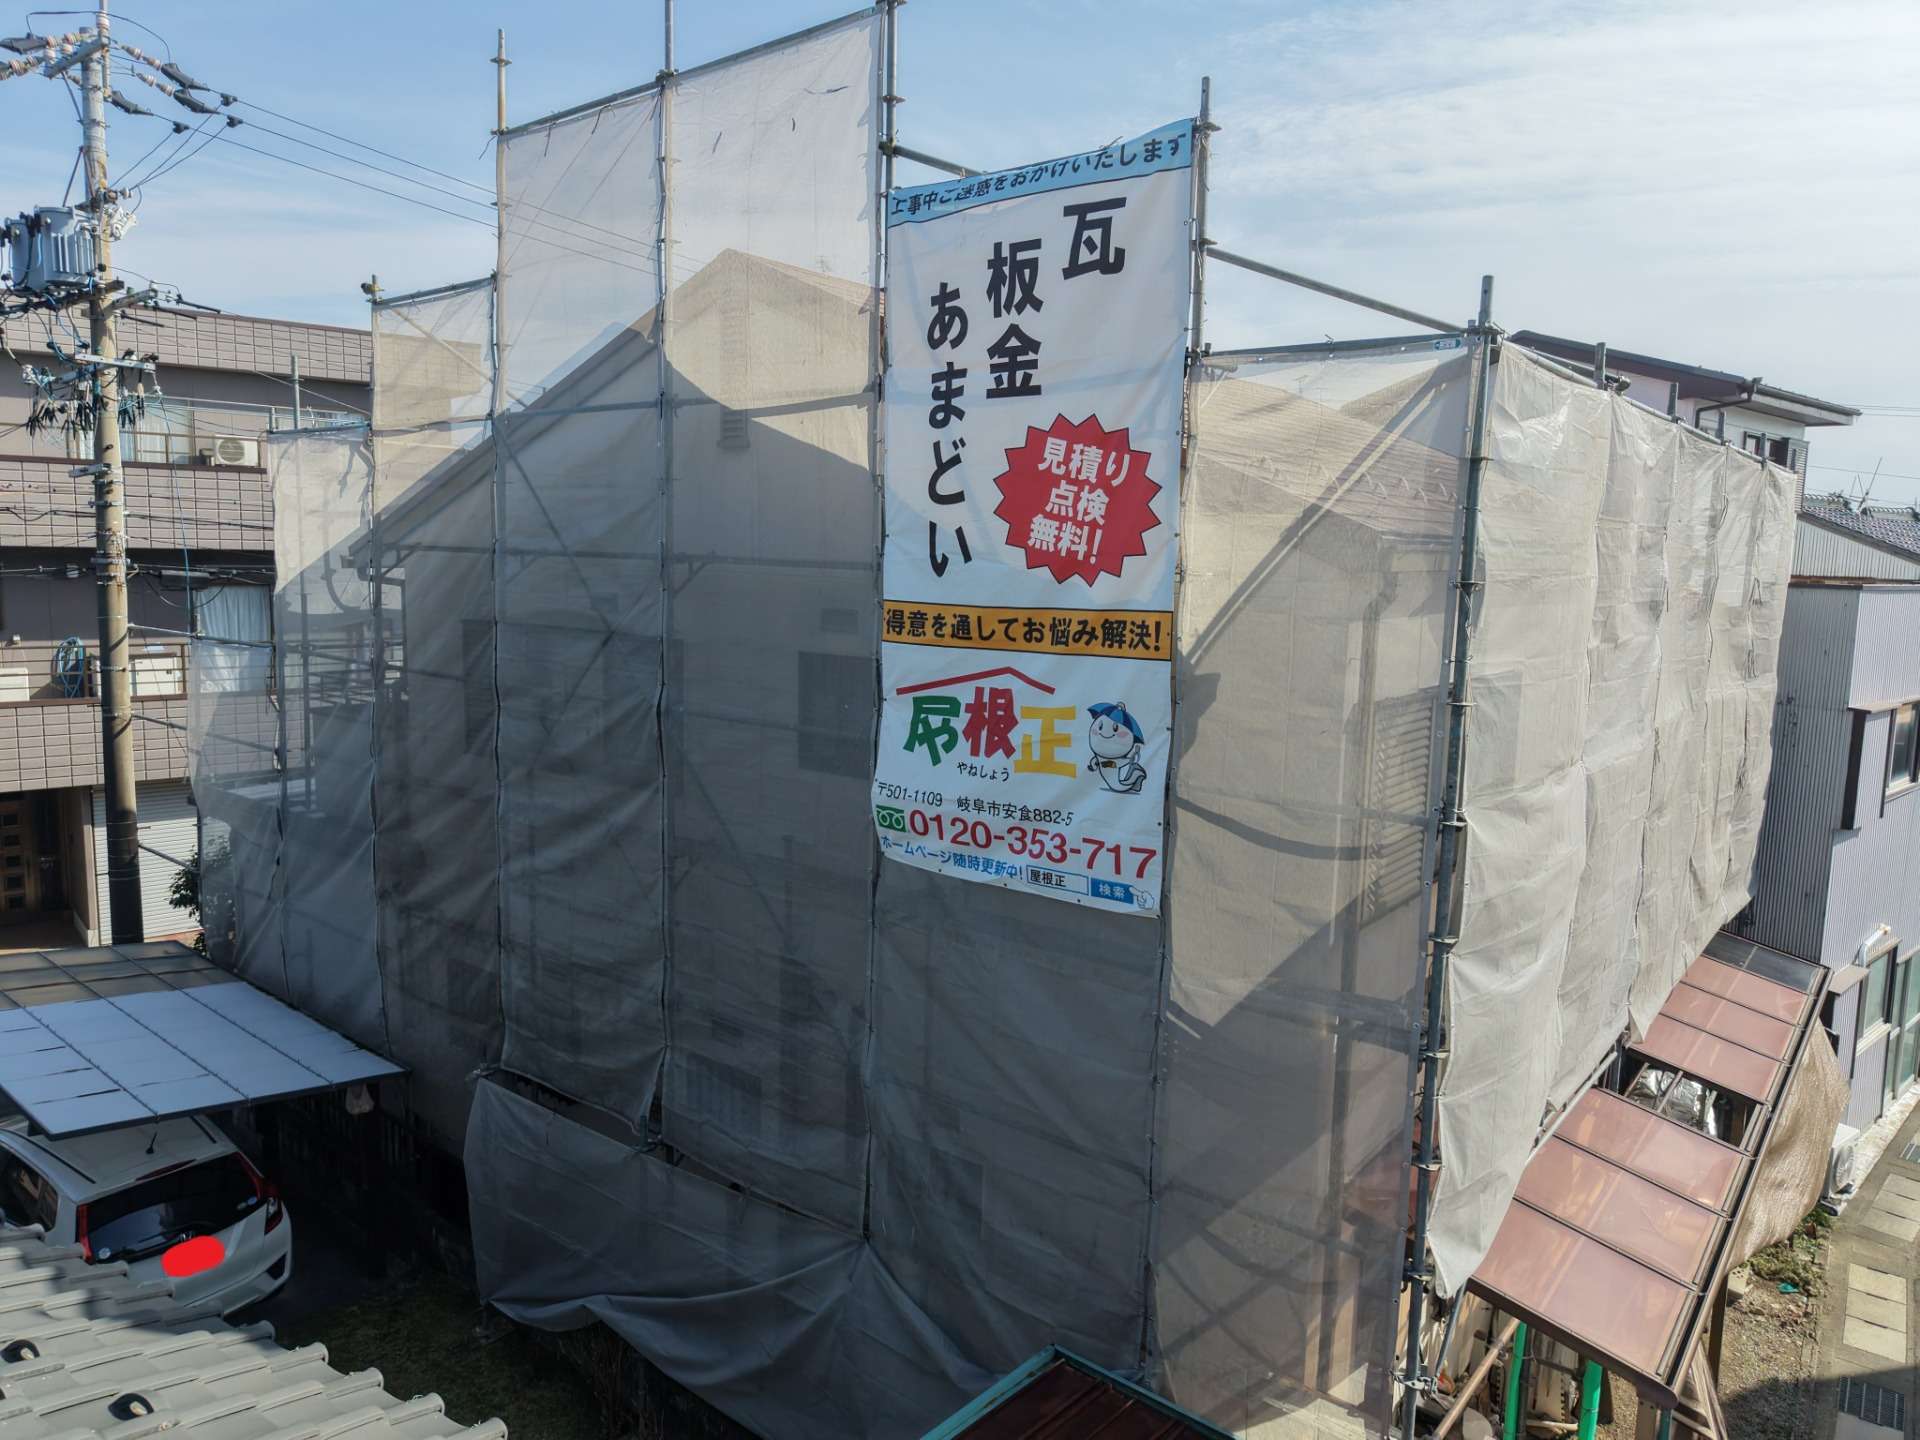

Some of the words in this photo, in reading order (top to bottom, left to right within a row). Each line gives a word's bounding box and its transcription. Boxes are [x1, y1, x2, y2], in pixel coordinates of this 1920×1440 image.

[1062, 196, 1127, 280] 瓦
[986, 238, 1044, 399] 板金
[926, 282, 973, 578] あまどい
[1038, 436, 1131, 487] 見積り
[1045, 480, 1110, 526] 点検
[956, 761, 1010, 783] やねしょう
[909, 809, 1157, 880] 0120-353-717
[1029, 868, 1067, 888] 屋根正
